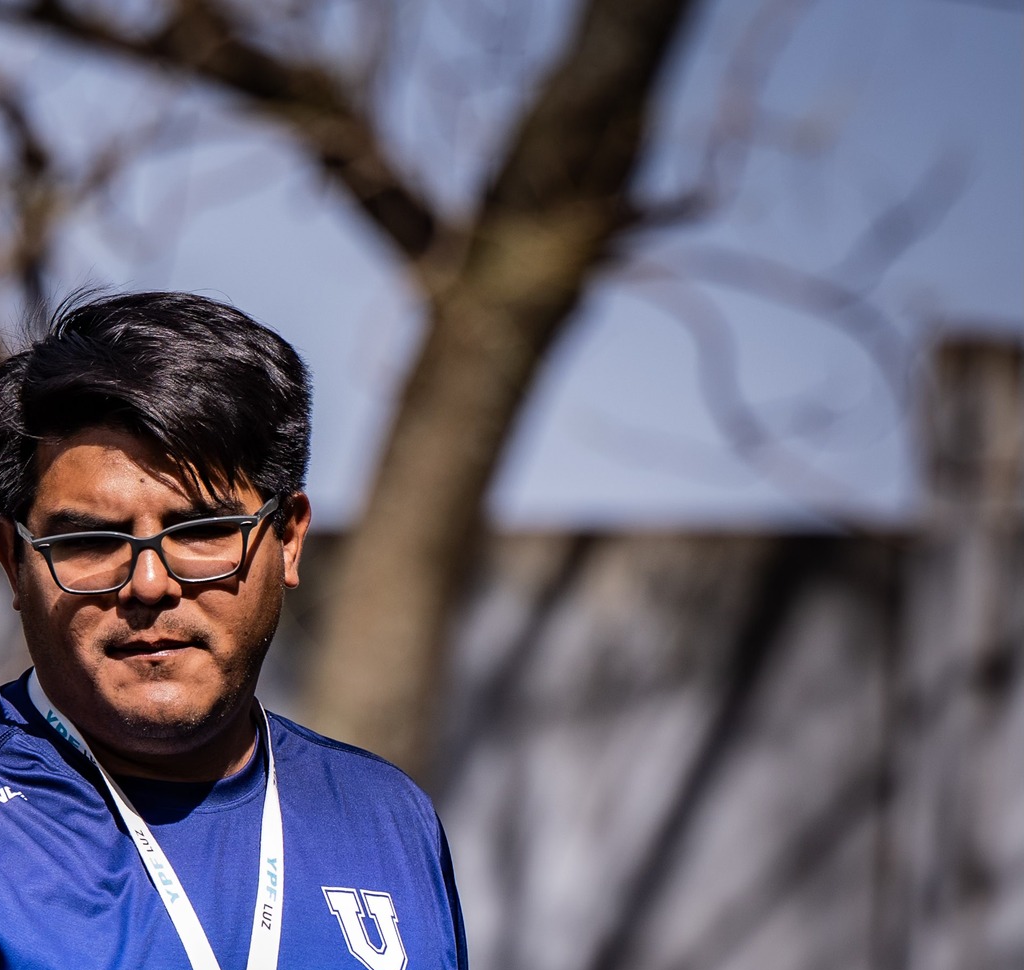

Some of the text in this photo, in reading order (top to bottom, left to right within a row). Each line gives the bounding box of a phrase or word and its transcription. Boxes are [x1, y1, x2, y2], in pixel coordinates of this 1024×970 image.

[135, 829, 180, 904] YPF LUZ
[261, 857, 278, 930] YPF LUZ
